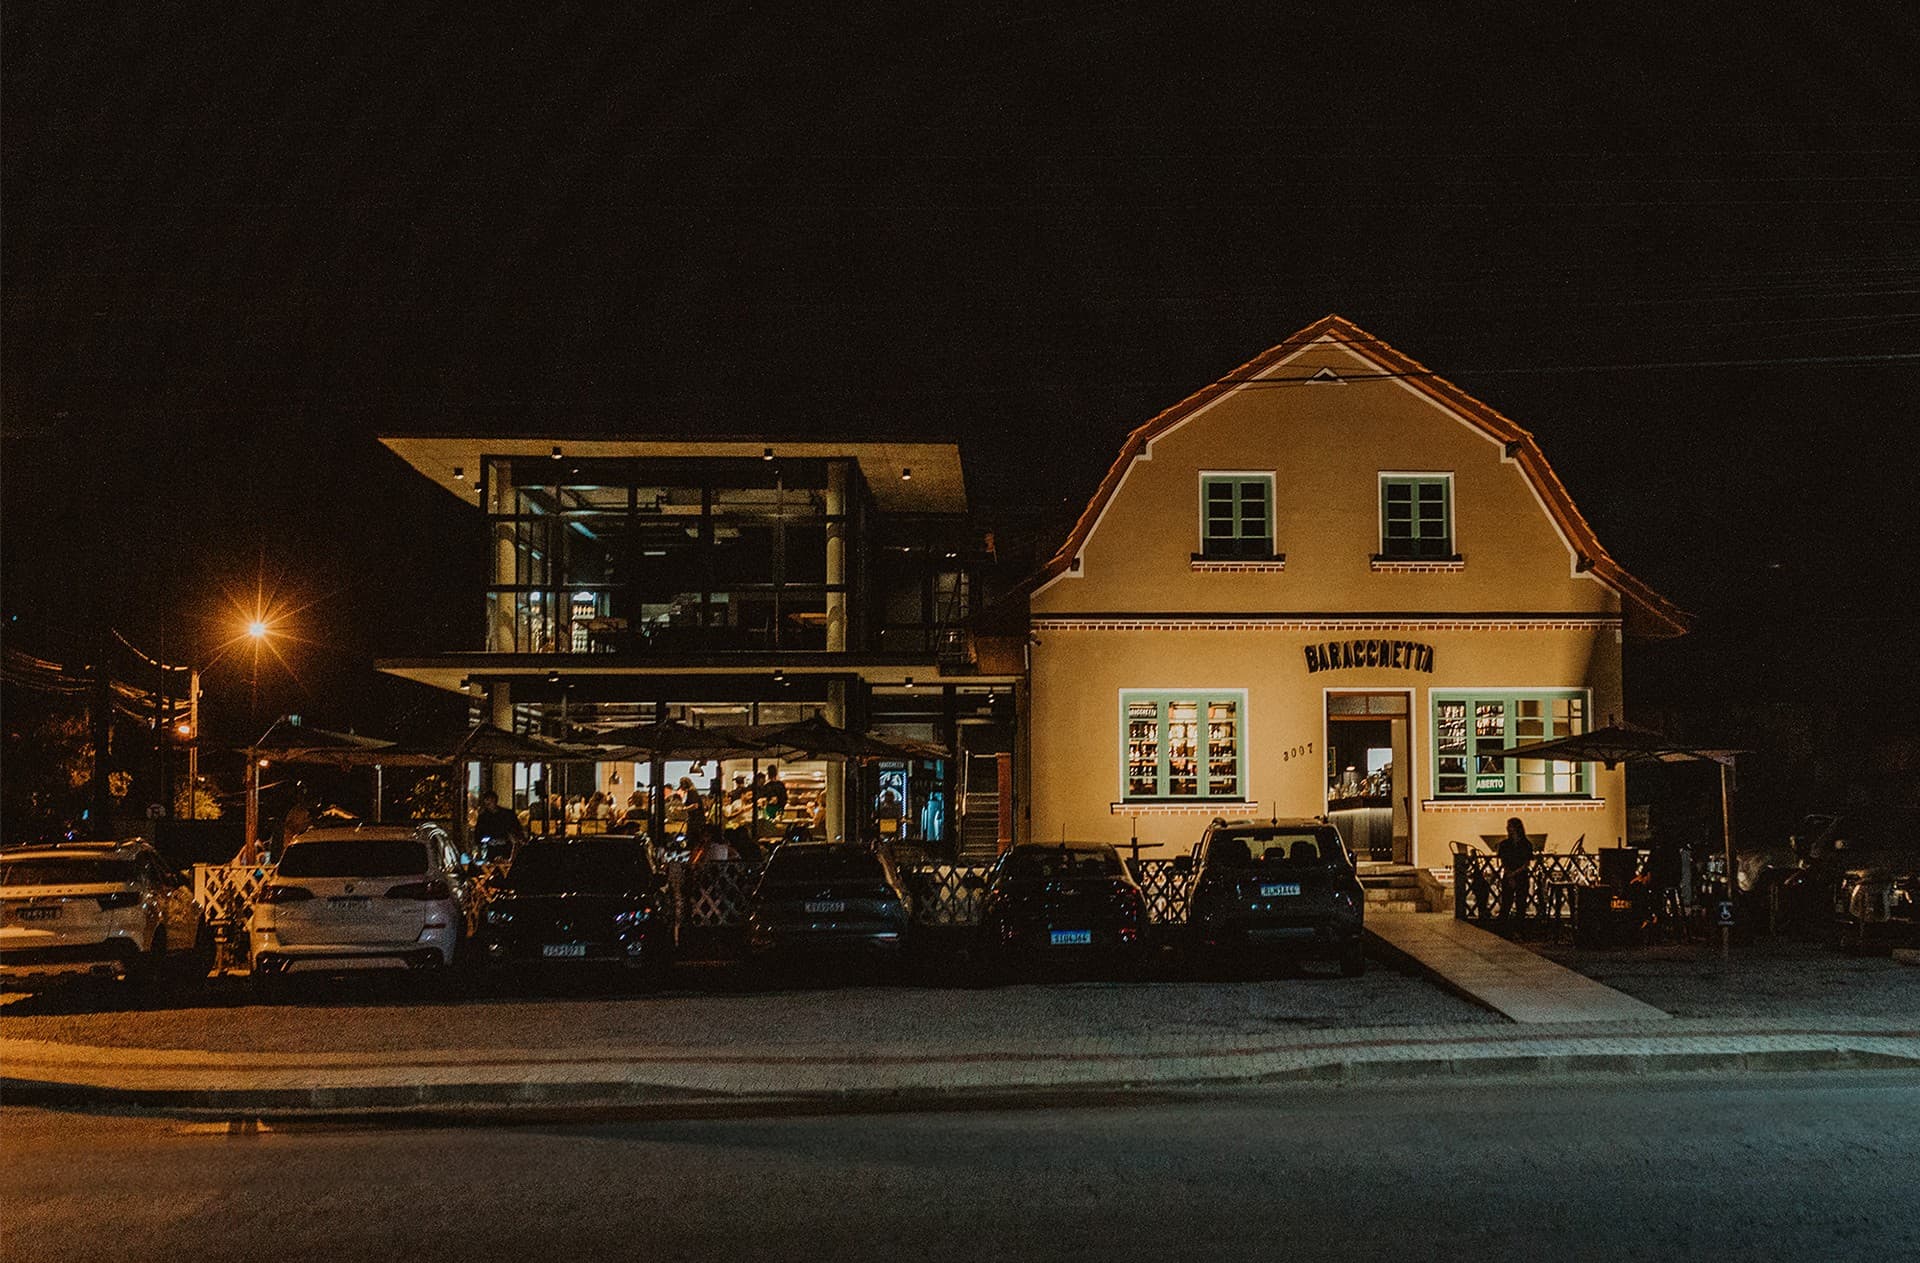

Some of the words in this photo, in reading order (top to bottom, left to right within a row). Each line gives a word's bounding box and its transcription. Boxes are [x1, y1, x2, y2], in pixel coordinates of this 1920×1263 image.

[1304, 639, 1434, 673] BARACCHETTA
[1283, 742, 1313, 762] 3007
[1476, 778, 1504, 790] ABERTO
